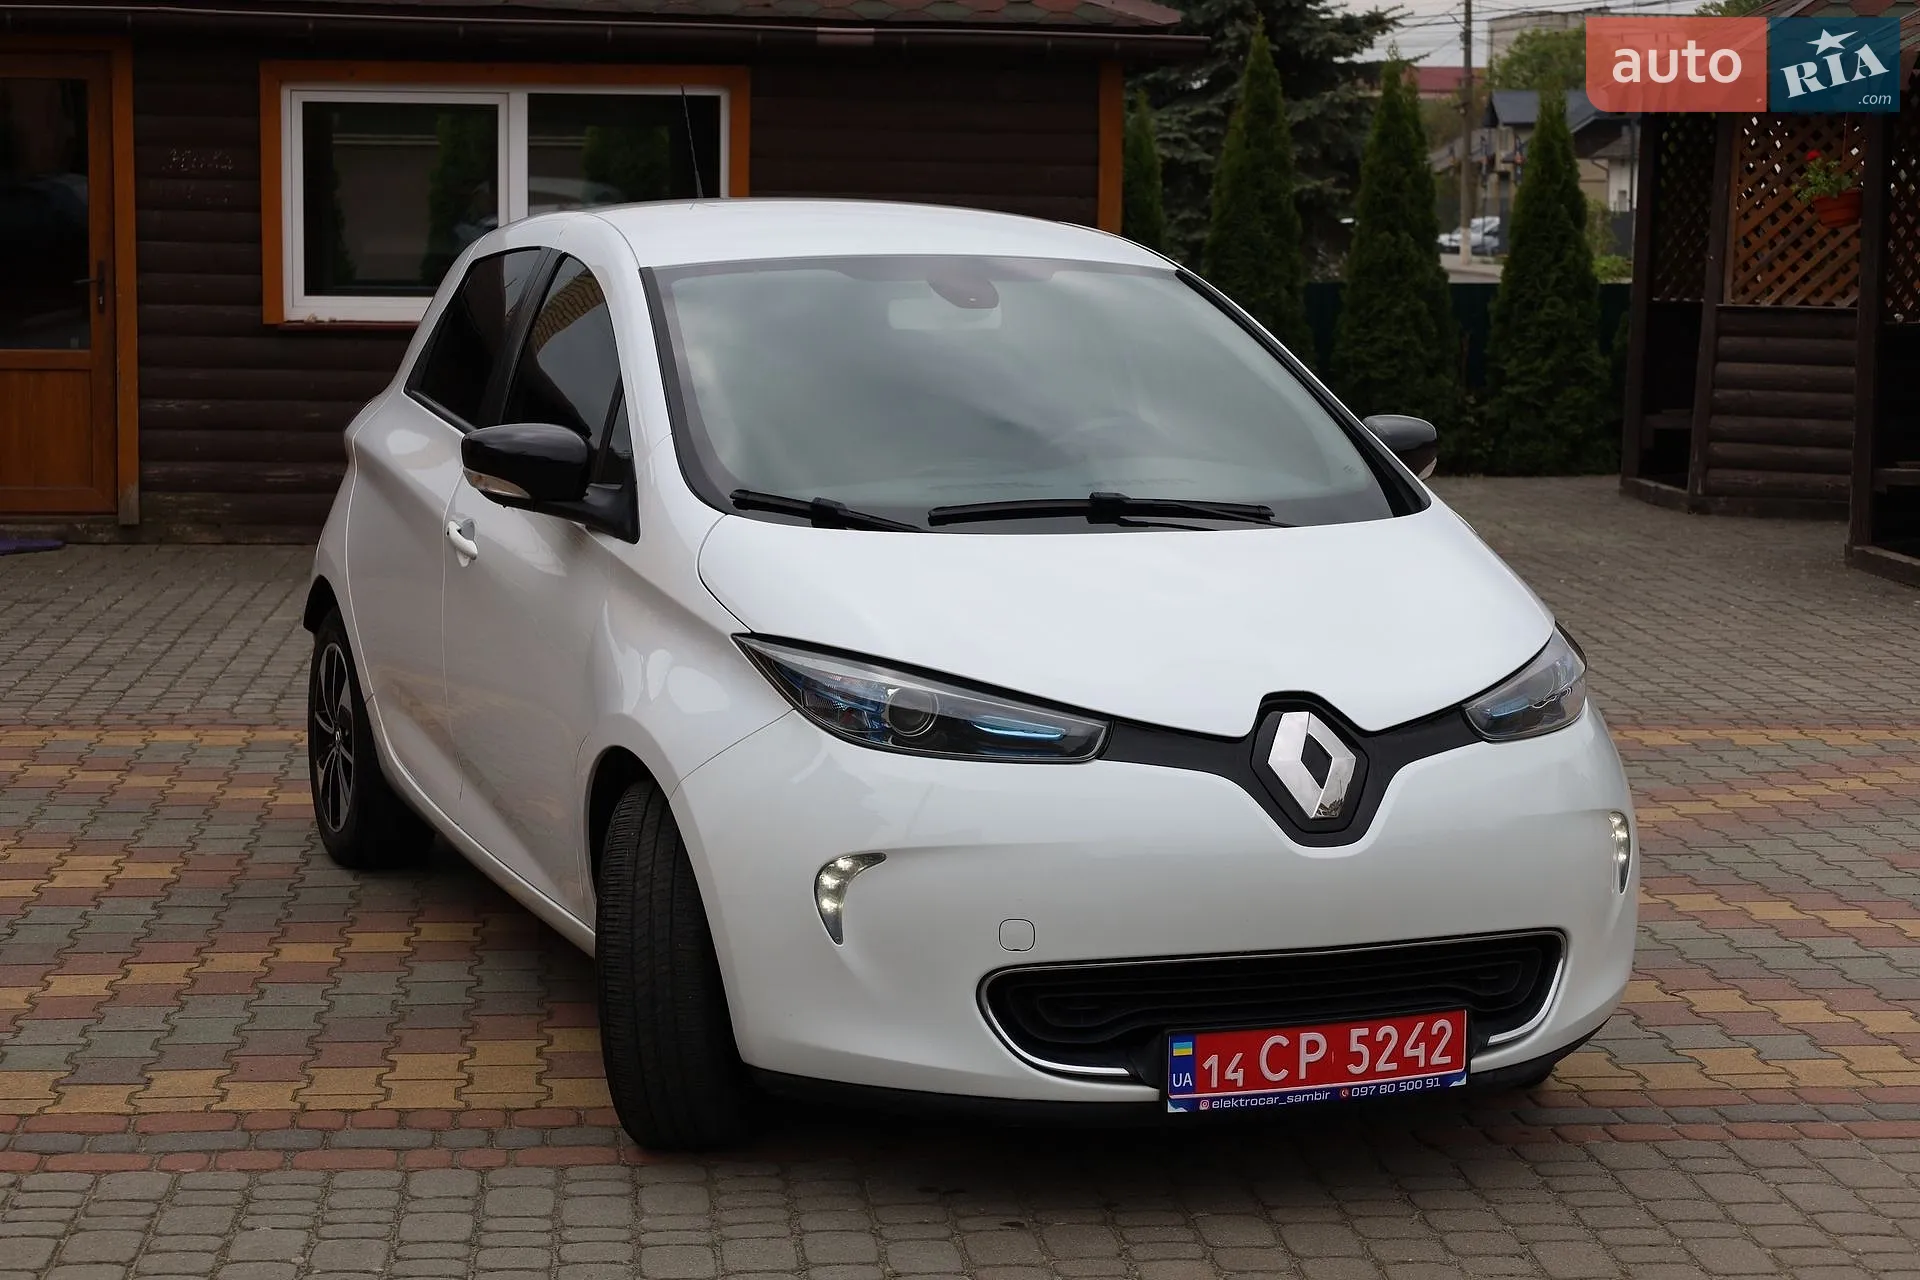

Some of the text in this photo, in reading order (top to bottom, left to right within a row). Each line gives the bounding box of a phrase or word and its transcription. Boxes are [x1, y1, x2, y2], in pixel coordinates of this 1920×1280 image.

[1202, 1019, 1453, 1088] 14 CP 5242
[1172, 1073, 1193, 1088] UA
[1211, 1077, 1441, 1109] elektrocar_sambir 097 80 500 91
